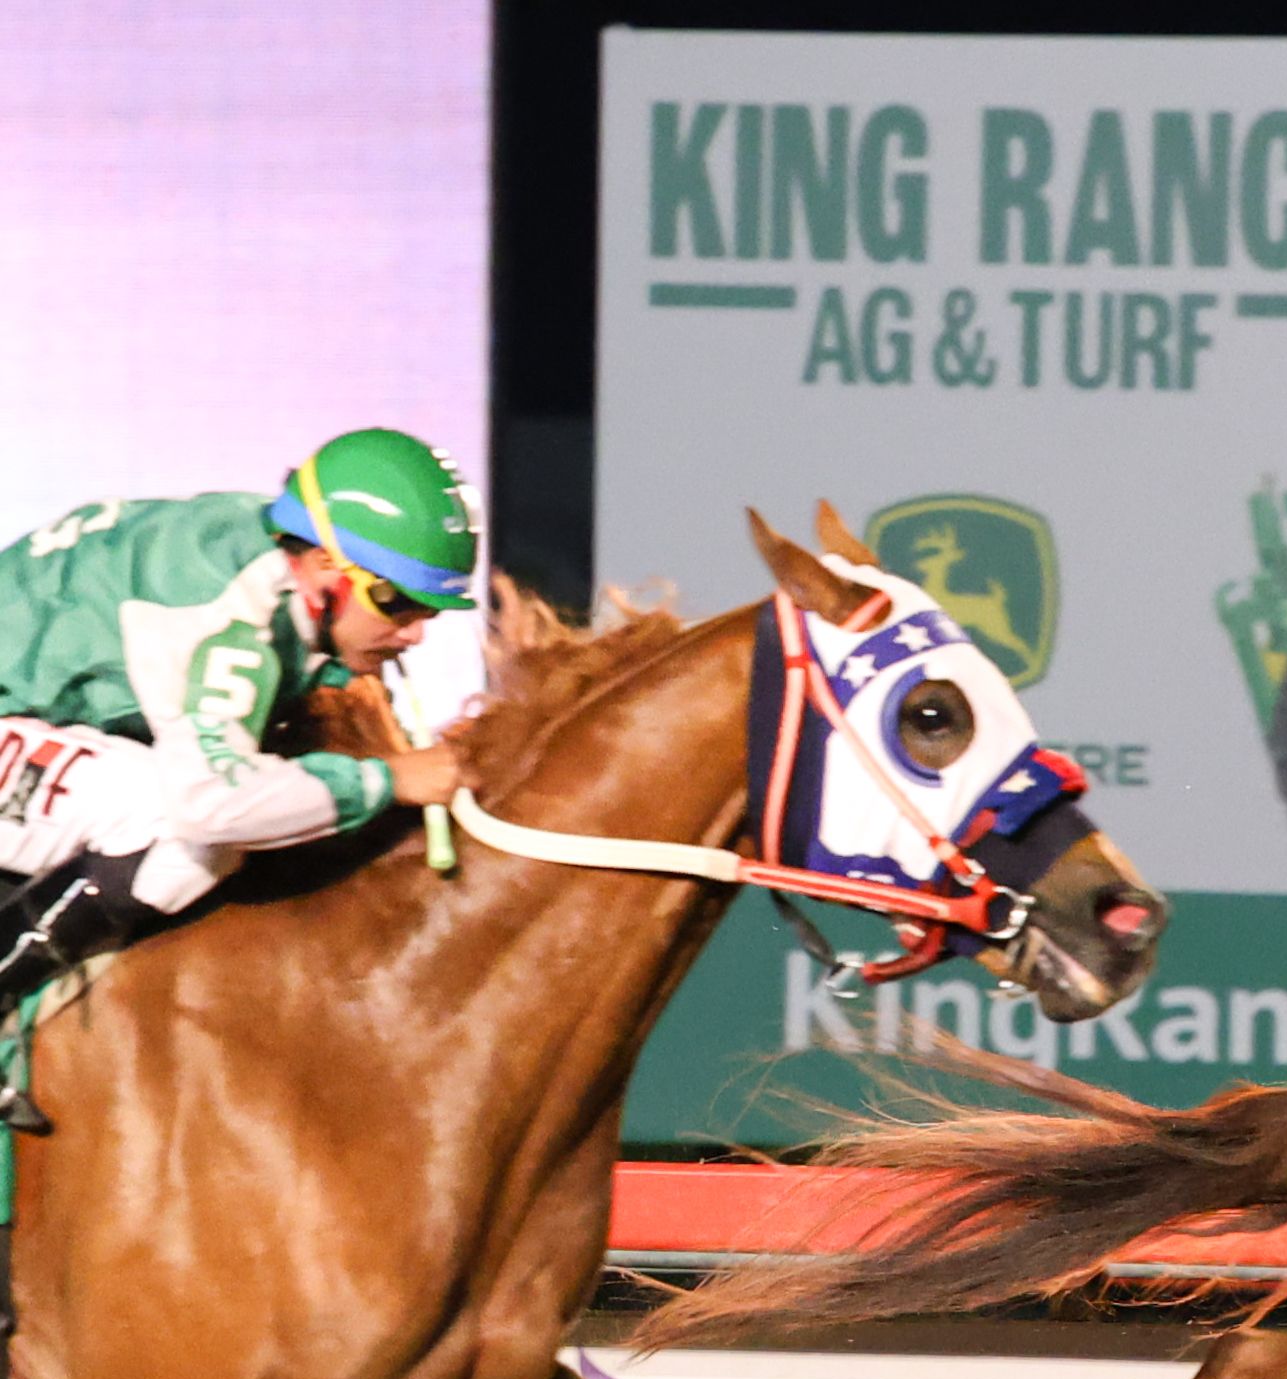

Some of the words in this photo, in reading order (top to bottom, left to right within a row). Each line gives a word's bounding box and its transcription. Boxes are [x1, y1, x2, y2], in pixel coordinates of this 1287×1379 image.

[649, 101, 930, 264] KING
[801, 286, 914, 387] AG
[1010, 290, 1219, 391] TURF
[197, 645, 263, 720] 5
